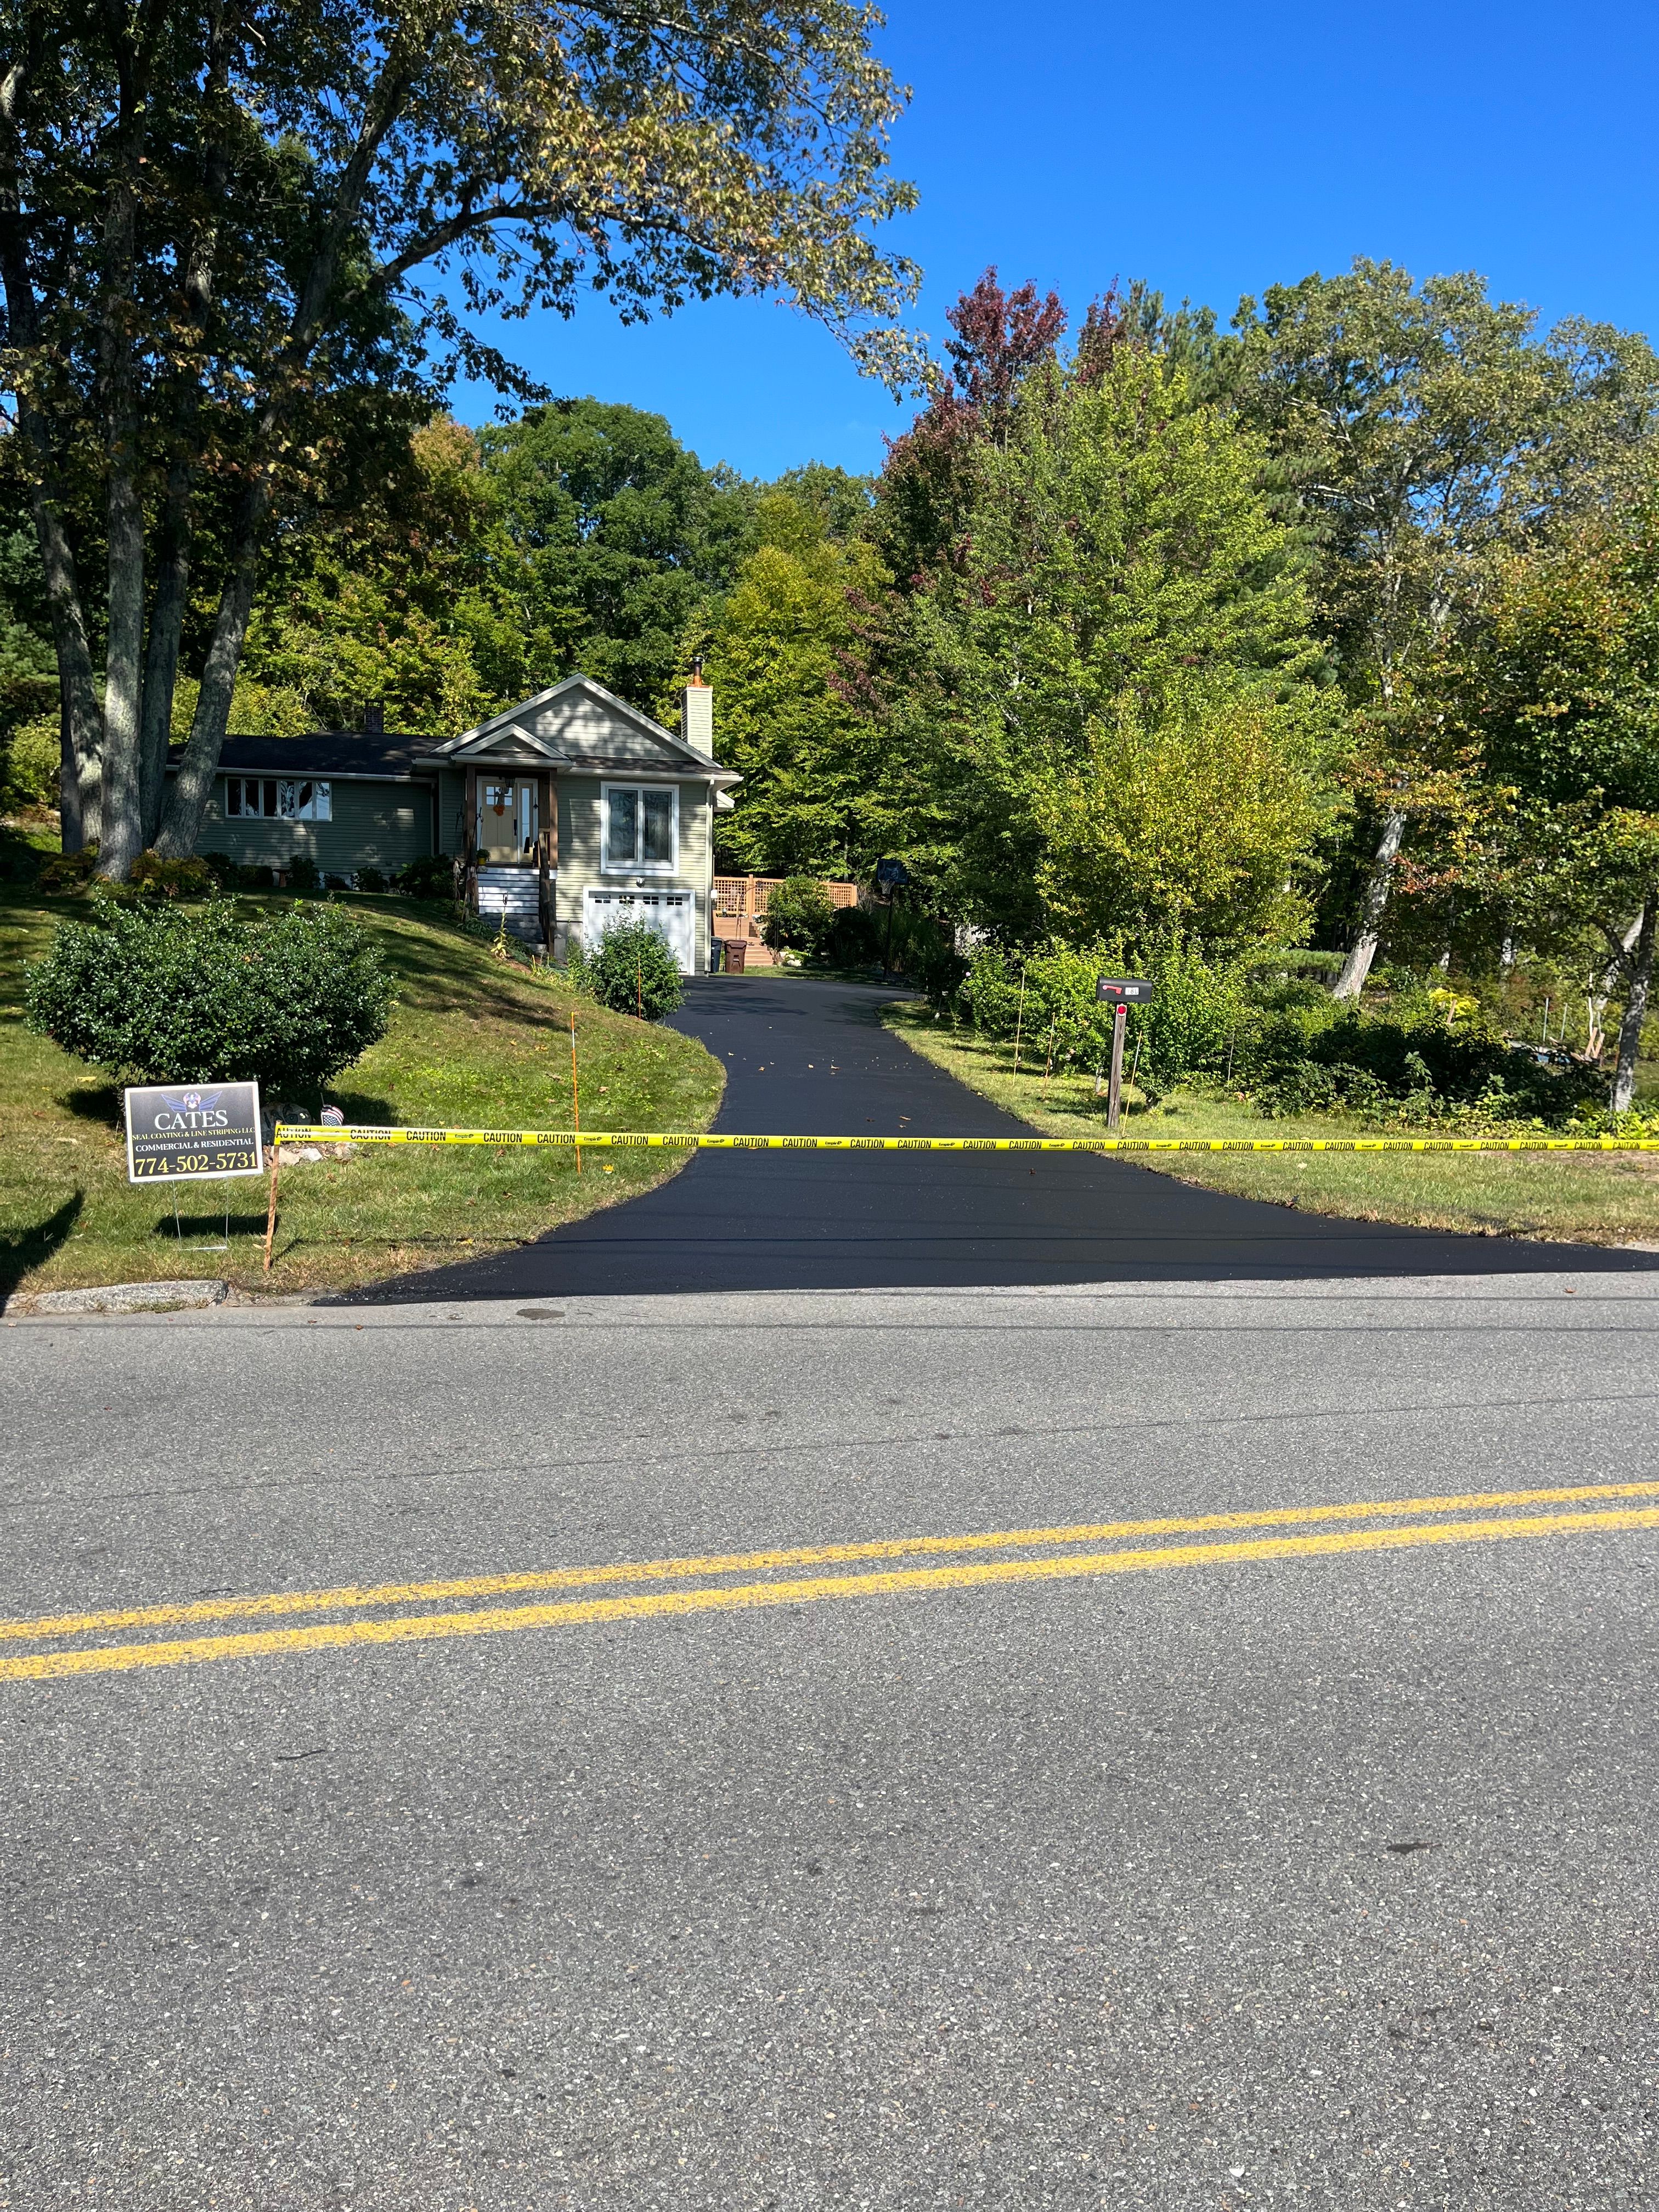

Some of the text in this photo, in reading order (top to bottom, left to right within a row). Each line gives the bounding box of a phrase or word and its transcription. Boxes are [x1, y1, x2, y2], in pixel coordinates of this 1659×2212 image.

[154, 1110, 228, 1130] CATES
[136, 1142, 193, 1152] COMMERCIAL
[201, 1138, 254, 1148] RESIDENTIAL
[276, 1128, 311, 1138] AUTION
[351, 1130, 391, 1140] CAUTION
[407, 1131, 445, 1142] CAUTION
[484, 1133, 522, 1143] CAUTION
[538, 1133, 575, 1144] CAUTION
[612, 1135, 648, 1146] CAUTION
[663, 1136, 699, 1147] CAUTION
[733, 1137, 769, 1147] CAUTION
[783, 1138, 817, 1148] CAUTION
[850, 1139, 884, 1149] CAUTION
[898, 1140, 931, 1149] CAUTION
[963, 1141, 996, 1149] CAUTION
[1009, 1141, 1041, 1150] CAUTION
[1073, 1141, 1105, 1150] CAUTION
[1117, 1141, 1149, 1150] CAUTION
[1180, 1141, 1211, 1150] CAUTION
[1223, 1142, 1254, 1150] CAUTION
[1283, 1142, 1313, 1150] CAUTION
[1325, 1142, 1355, 1150] CAUTION
[1384, 1142, 1413, 1150] CAUTION
[1424, 1142, 1453, 1150] CAUTION
[1481, 1142, 1509, 1150] CAUTION
[1520, 1142, 1548, 1150] CAUTION
[1574, 1142, 1602, 1150] CAUTION
[1612, 1142, 1640, 1150] CAUTION
[135, 1151, 257, 1175] 774-502-5731
